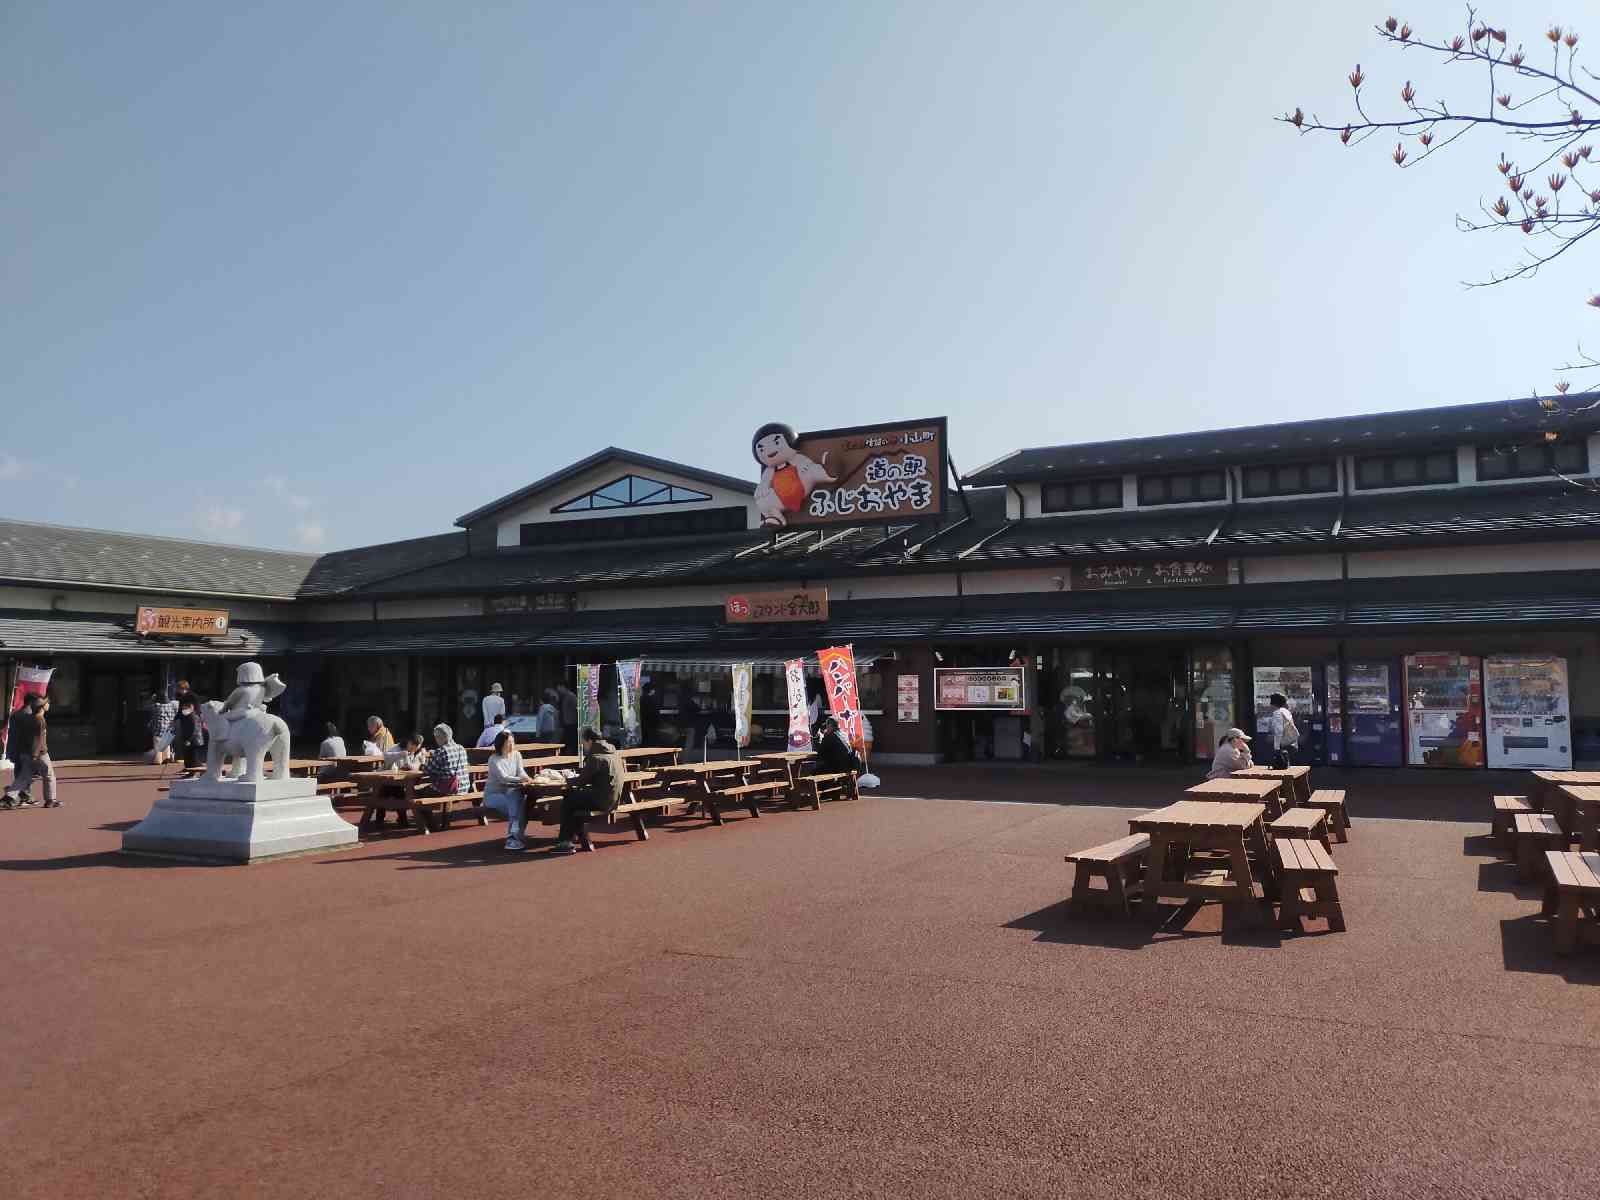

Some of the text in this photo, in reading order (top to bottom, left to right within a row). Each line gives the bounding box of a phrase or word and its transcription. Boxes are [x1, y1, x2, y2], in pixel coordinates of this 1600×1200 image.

[866, 454, 927, 483] 道の駅
[809, 478, 932, 517] ふじおやま
[158, 615, 216, 629] 観光案内所
